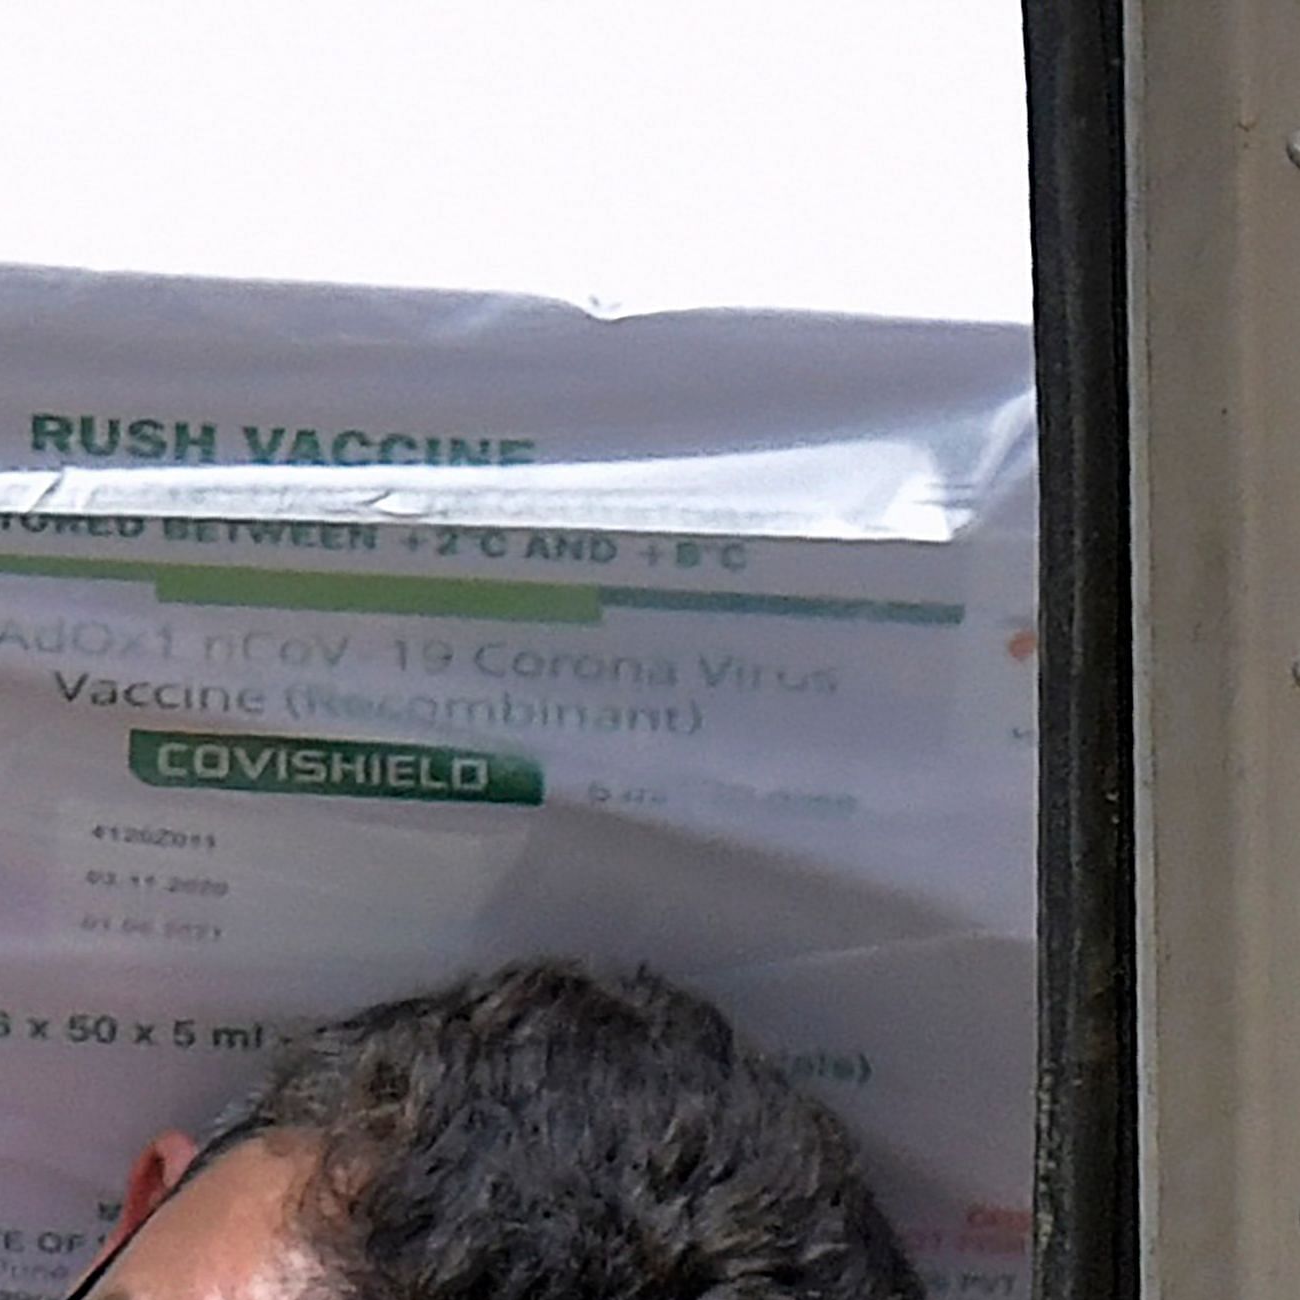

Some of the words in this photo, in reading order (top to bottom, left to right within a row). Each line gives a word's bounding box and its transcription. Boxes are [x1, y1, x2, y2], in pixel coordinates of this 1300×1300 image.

[31, 413, 215, 462] RUSH
[243, 426, 535, 467] VACCINE
[163, 517, 379, 550] BETWEEN
[525, 533, 618, 563] AND
[473, 642, 679, 689] Corona
[700, 655, 839, 694] Virus
[54, 670, 267, 713] Vaccine
[157, 741, 489, 791] COVISHIELD
[27, 1017, 48, 1041] x
[66, 1013, 119, 1045] 50
[134, 1021, 156, 1046] x
[172, 1018, 197, 1050] 5
[211, 1020, 262, 1050] ml
[36, 1231, 85, 1254] OF
